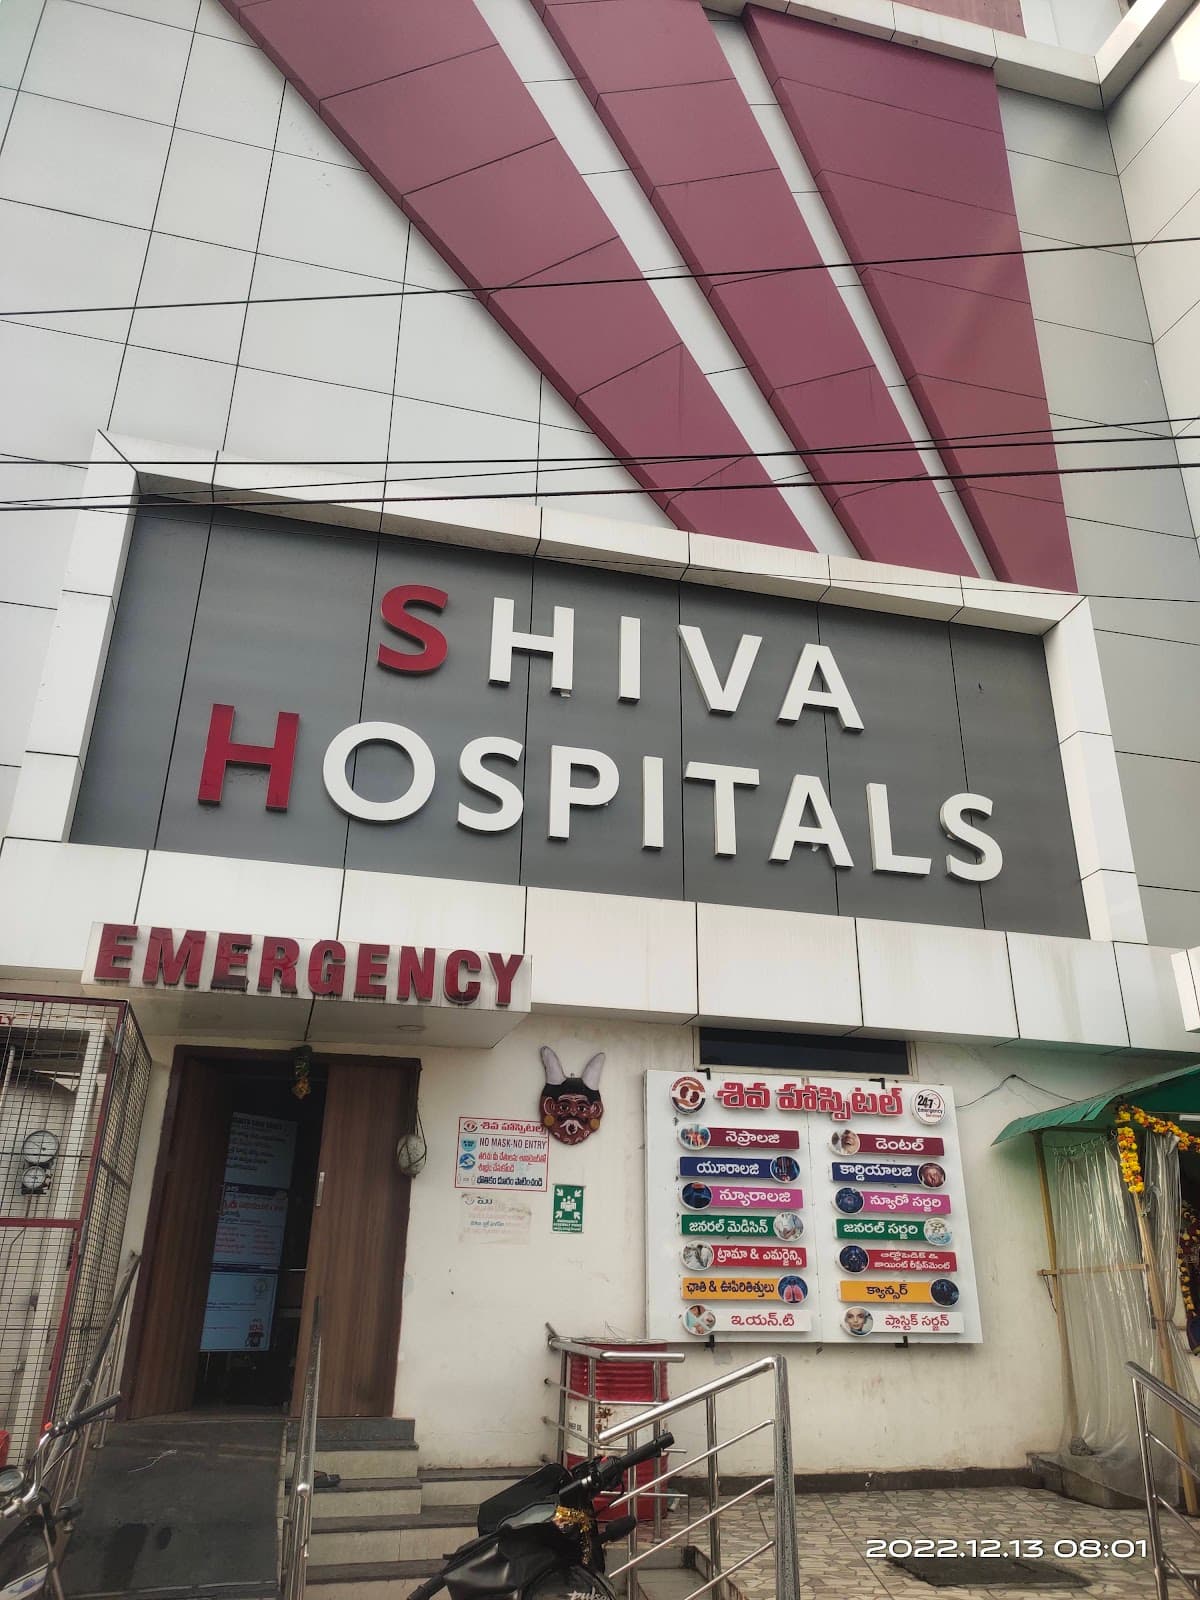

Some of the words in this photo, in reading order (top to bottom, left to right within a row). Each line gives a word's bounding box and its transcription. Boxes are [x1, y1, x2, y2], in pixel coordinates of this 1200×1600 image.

[377, 584, 865, 733] SHIVA
[197, 703, 1003, 883] HOSPITALS
[94, 923, 525, 1006] EMERGENCY
[715, 1081, 771, 1109] శివ
[776, 1082, 904, 1121] హాస్పిటల్
[479, 1137, 489, 1147] NO
[524, 1140, 547, 1150] ENTRY
[875, 1137, 925, 1151] డెంటల్
[719, 1188, 792, 1207] న్యూరాలజి
[870, 1194, 910, 1210] న్యూరో
[688, 1218, 725, 1233] జనరల్
[727, 1219, 769, 1234] మెడిసిన్
[843, 1221, 885, 1234] జనరల్
[717, 1247, 748, 1263] ట్రామా
[749, 1247, 760, 1260] &
[708, 1279, 718, 1293] &
[866, 1283, 909, 1300] క్యాన్సర్
